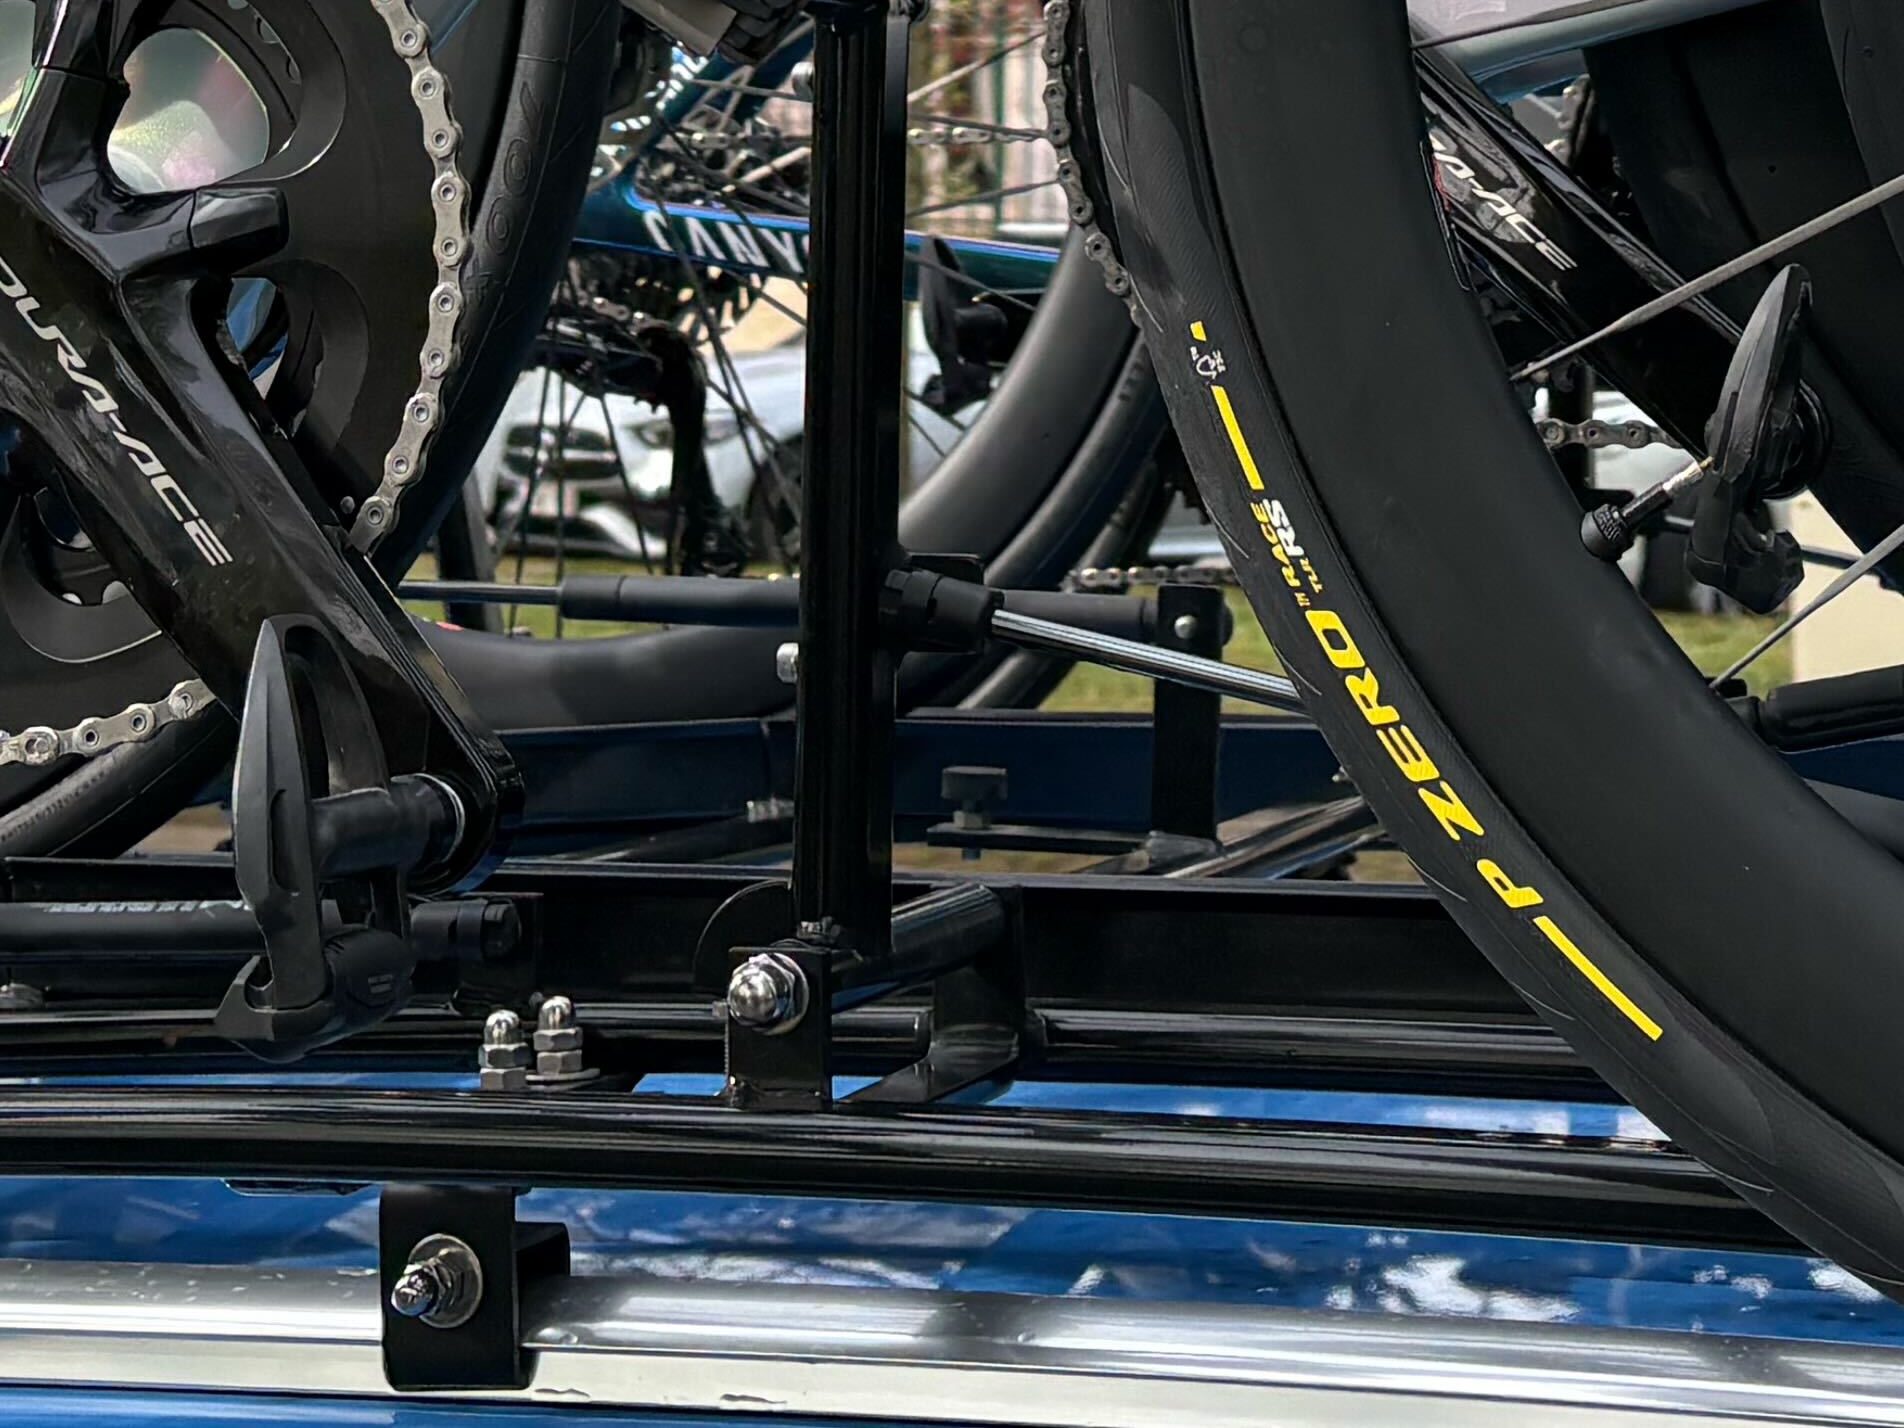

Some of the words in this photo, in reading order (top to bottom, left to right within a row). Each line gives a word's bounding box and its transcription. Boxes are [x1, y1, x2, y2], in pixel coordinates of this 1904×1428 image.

[1250, 500, 1299, 594] RACE
[1262, 497, 1306, 558] RS
[1304, 609, 1486, 842] ZERO
[1476, 857, 1544, 909] P
